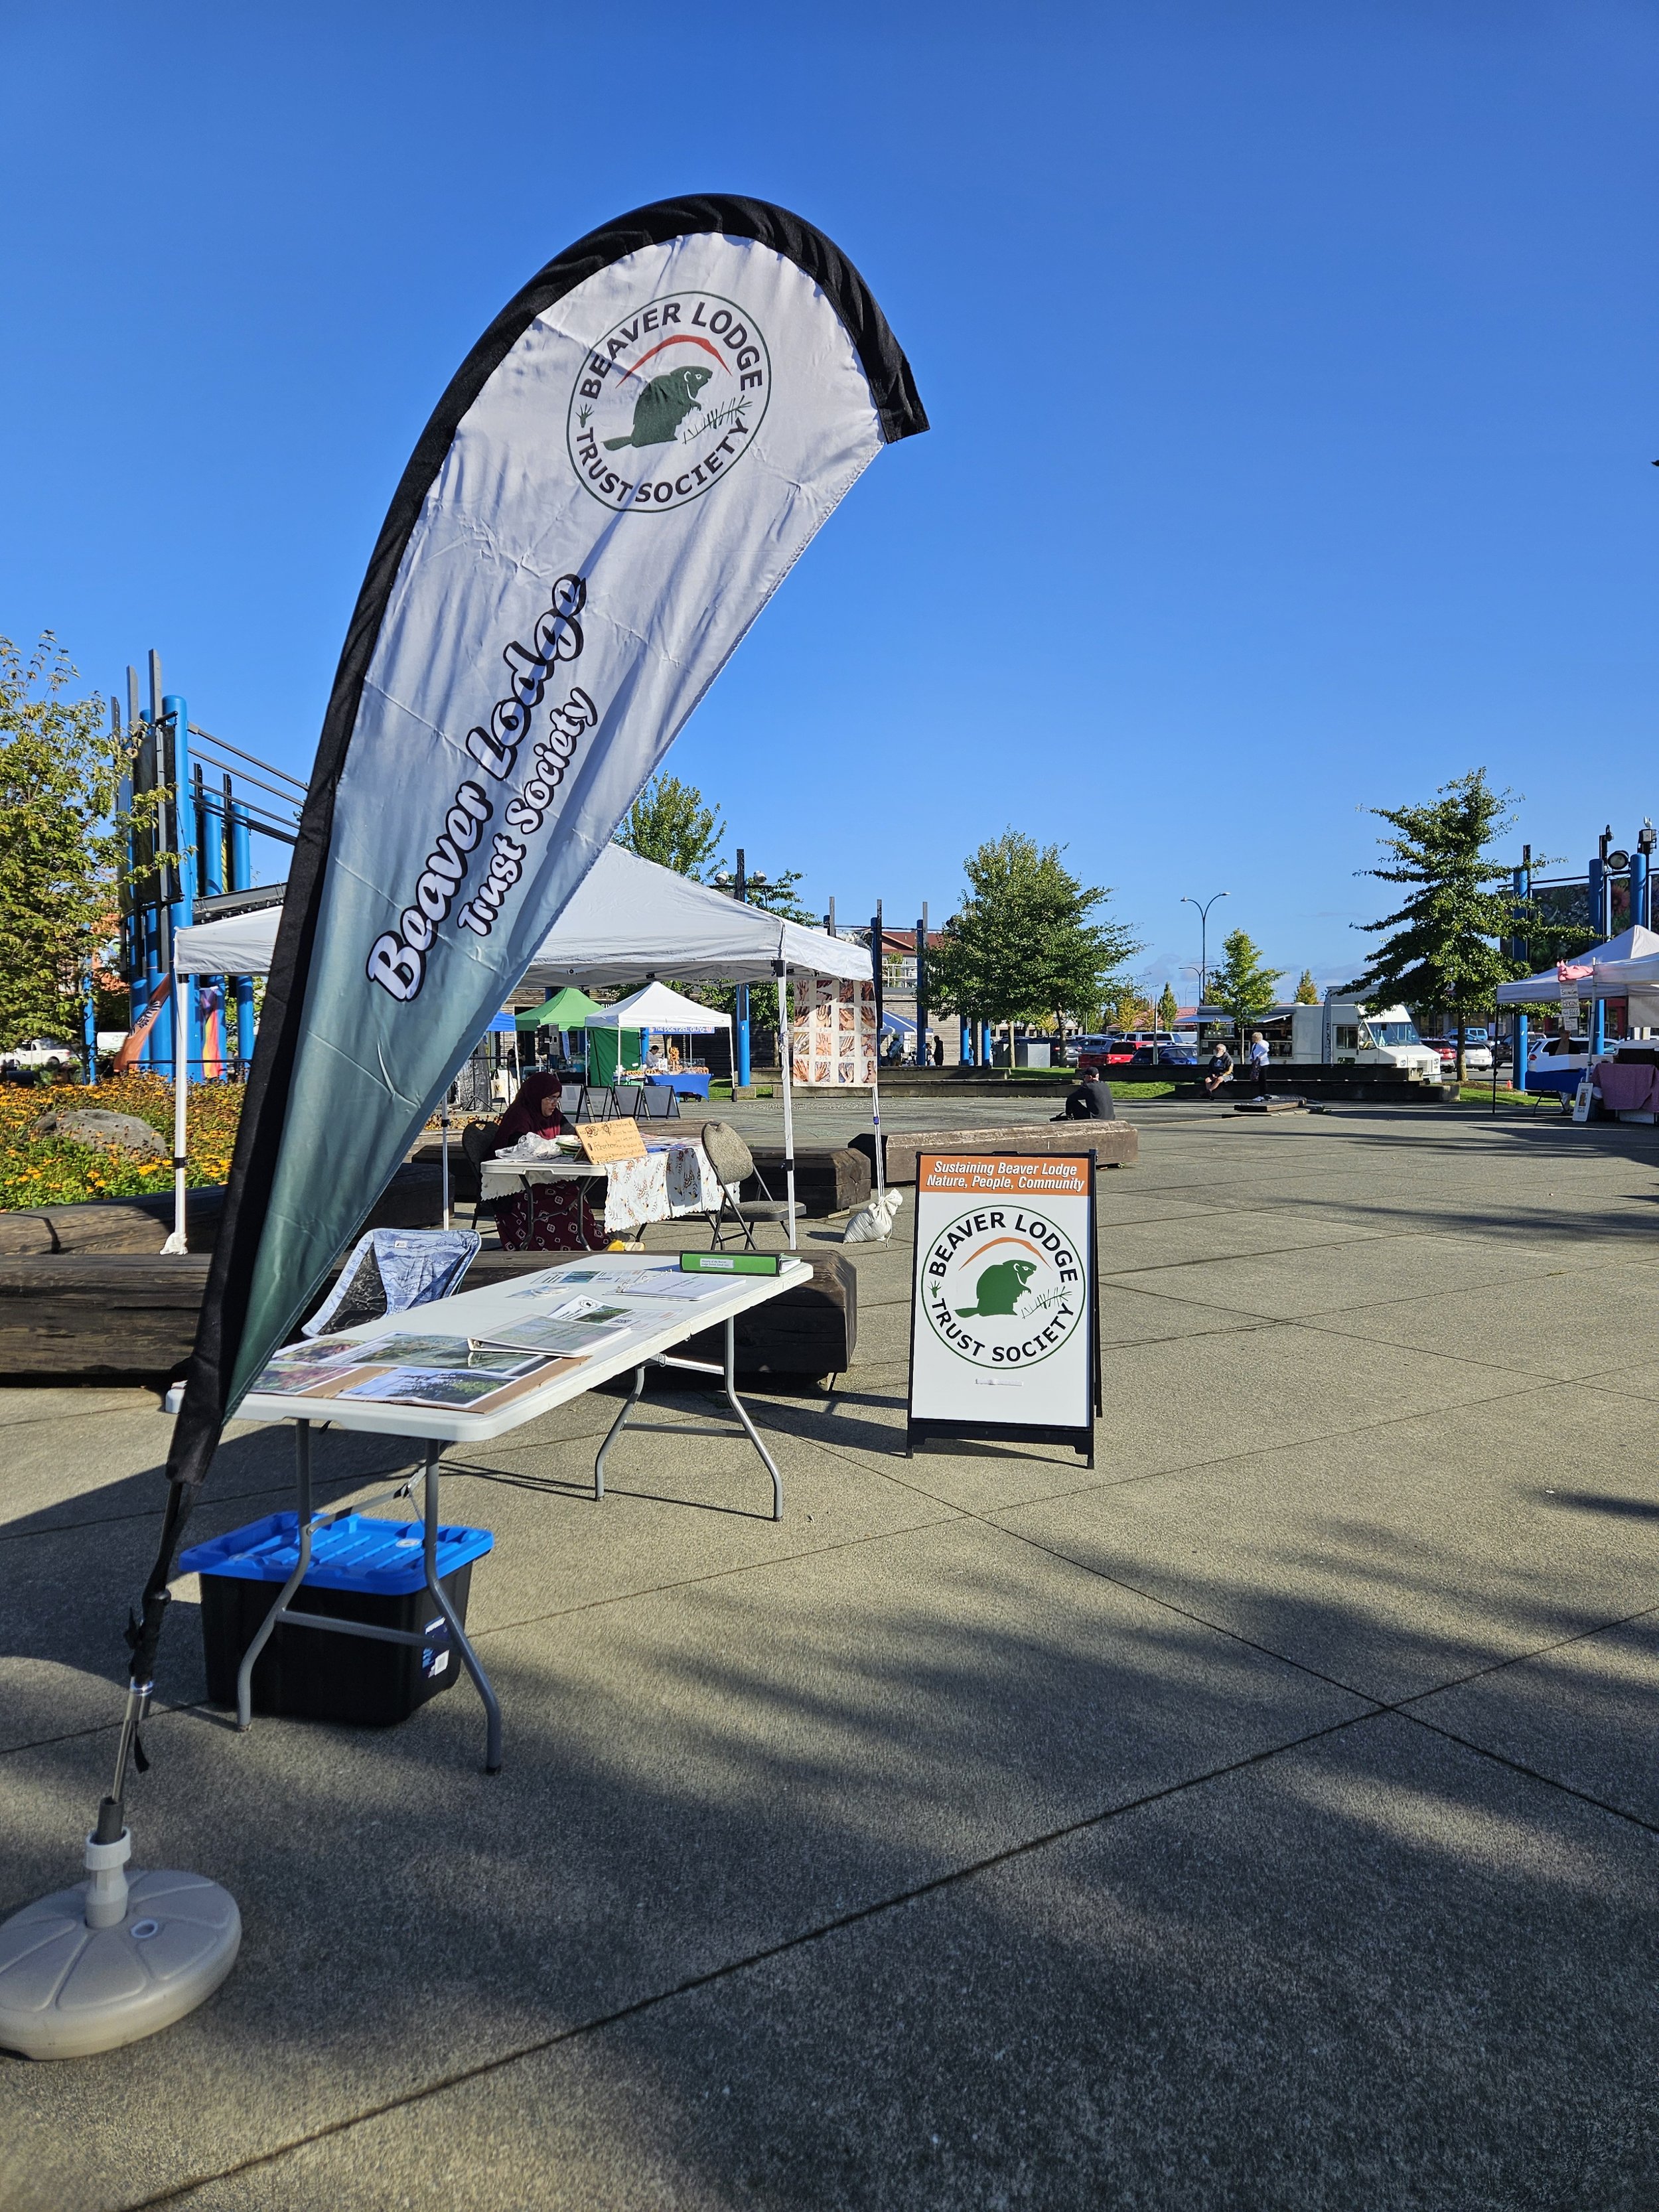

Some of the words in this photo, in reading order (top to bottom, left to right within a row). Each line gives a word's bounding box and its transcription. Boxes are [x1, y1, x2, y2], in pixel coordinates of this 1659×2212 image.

[579, 302, 681, 400] BEAVER
[691, 301, 762, 392] LODGE
[576, 426, 633, 502] TRUST
[635, 417, 749, 503] SOCIETY
[366, 780, 492, 1002] Beaver
[466, 573, 587, 780] Lodge
[458, 833, 526, 936] Trust
[504, 687, 597, 834] Society
[927, 1174, 968, 1189] Nature,
[972, 1176, 1014, 1190] People,
[1018, 1177, 1084, 1192] Community
[934, 1161, 994, 1176] Sustaining
[997, 1162, 1039, 1175] Beaver
[1041, 1163, 1077, 1177] Lodge
[929, 1212, 1007, 1278] BEAVER
[1015, 1214, 1078, 1283] LODGE
[932, 1297, 985, 1358] TRUST
[991, 1303, 1074, 1363] SOCIETY
